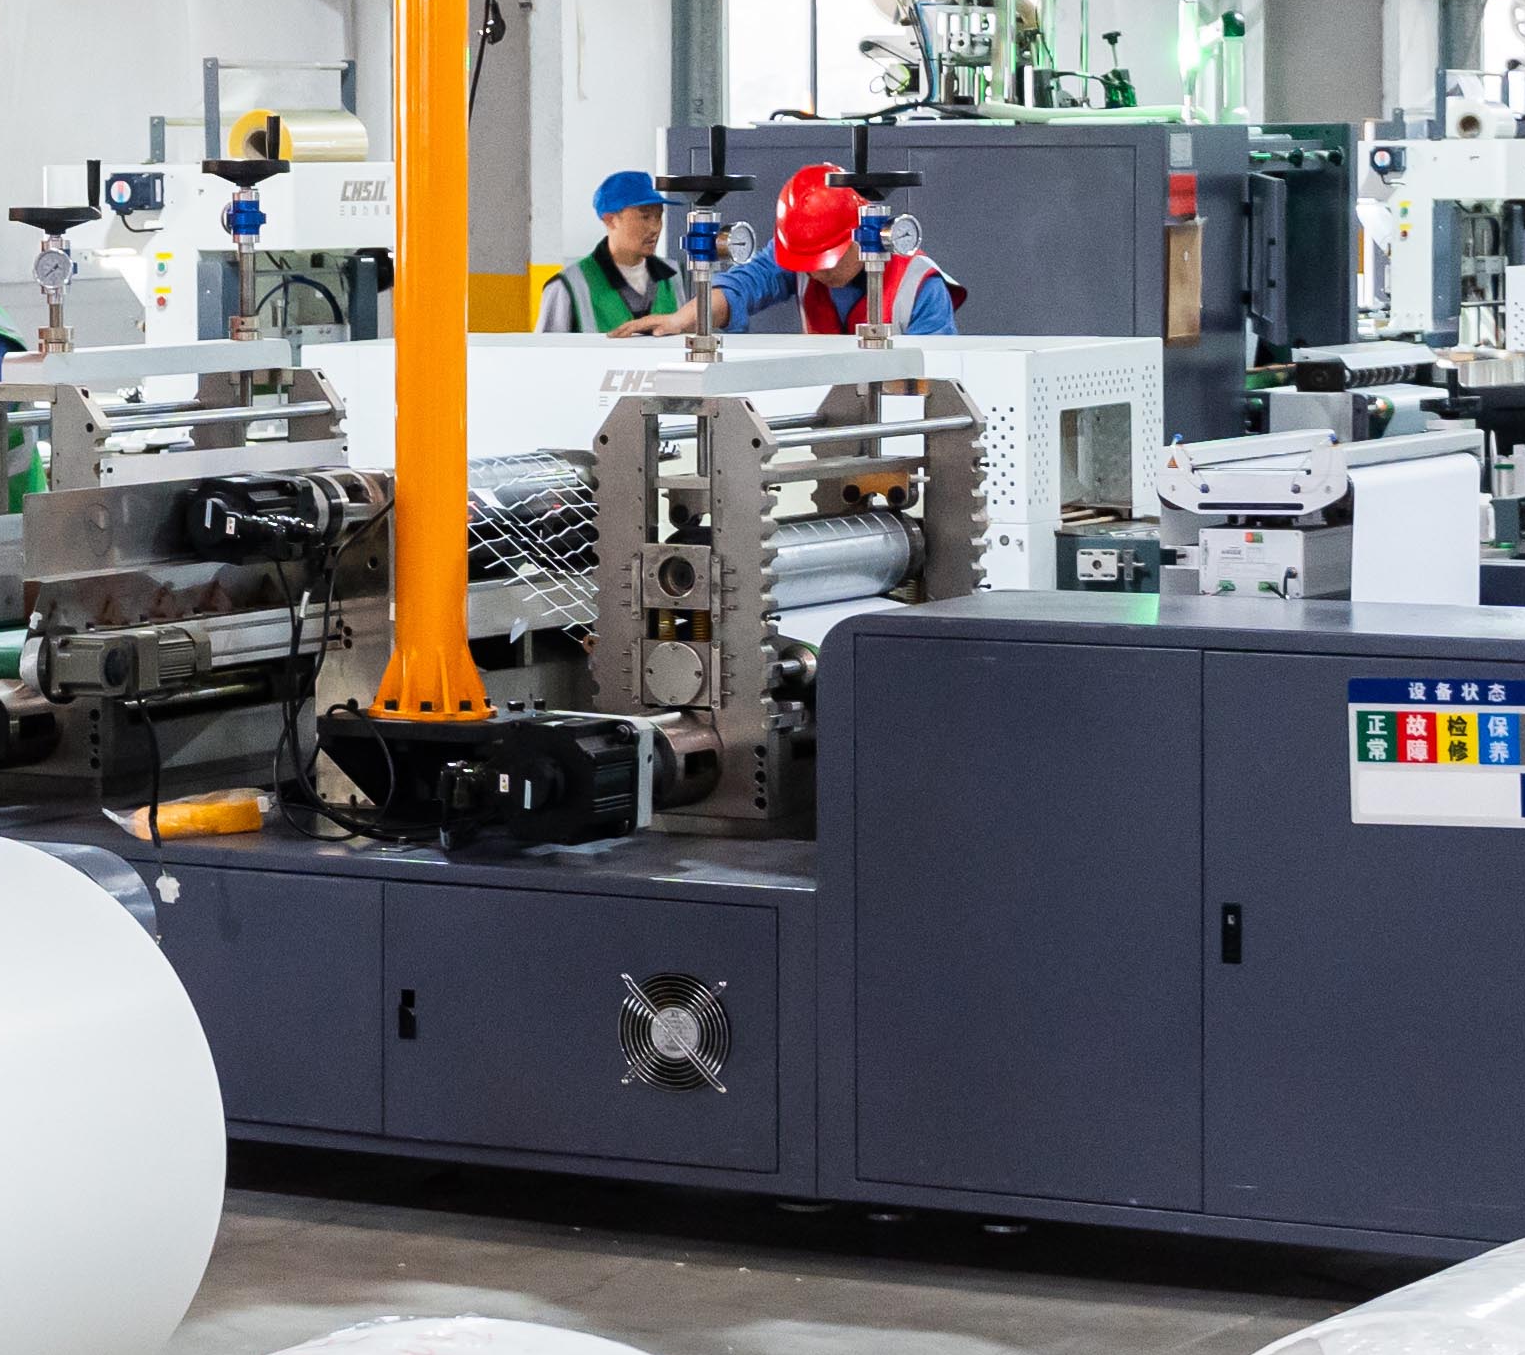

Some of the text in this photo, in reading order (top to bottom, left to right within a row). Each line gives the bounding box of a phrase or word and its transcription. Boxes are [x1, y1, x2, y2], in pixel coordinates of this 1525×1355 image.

[1408, 681, 1507, 702] 设备状态
[1365, 714, 1388, 761] 正常
[1405, 714, 1430, 762] 故障
[1447, 715, 1469, 762] 检修
[1487, 716, 1511, 764] 保养
